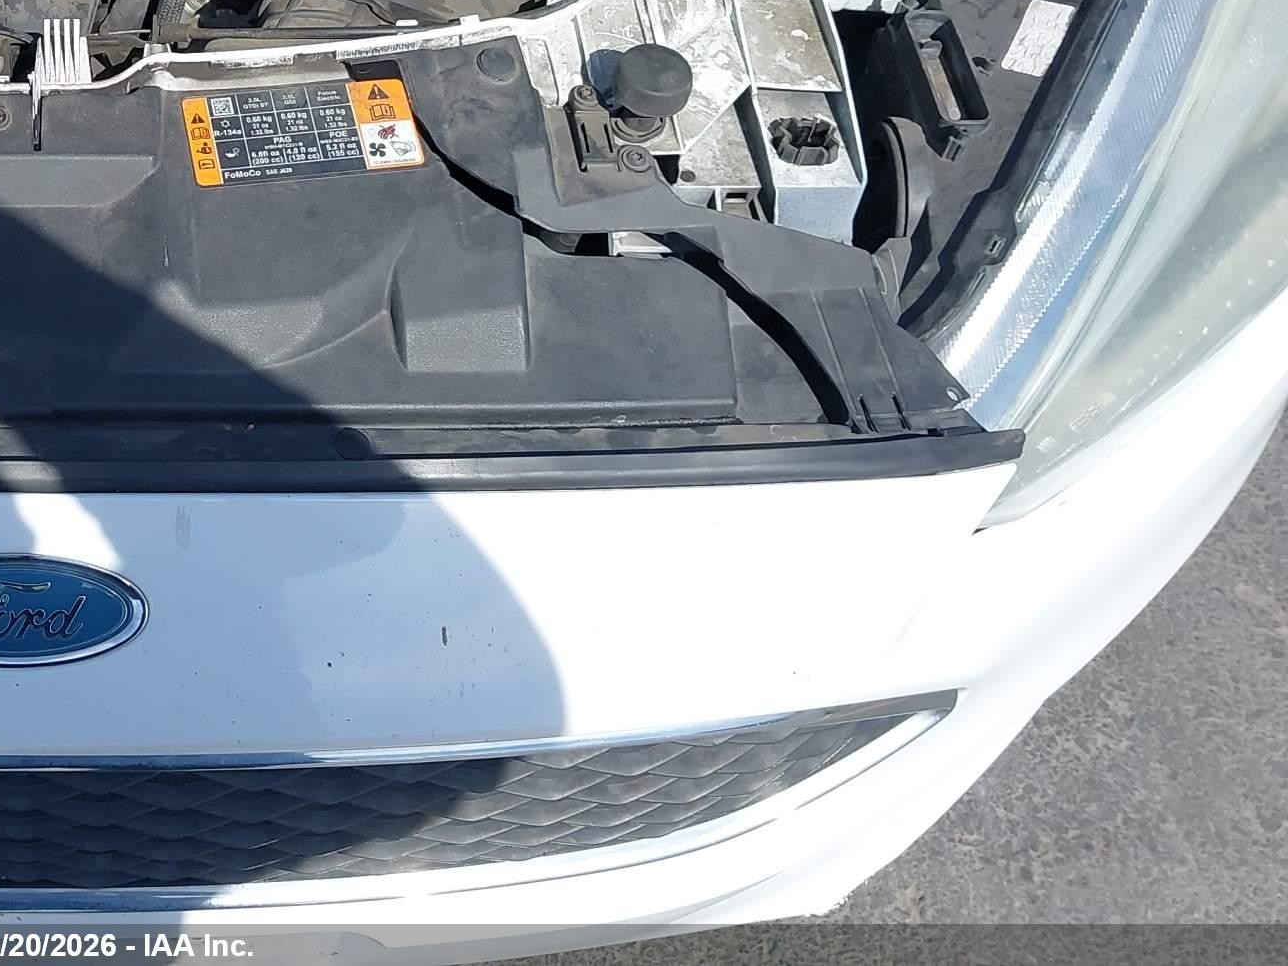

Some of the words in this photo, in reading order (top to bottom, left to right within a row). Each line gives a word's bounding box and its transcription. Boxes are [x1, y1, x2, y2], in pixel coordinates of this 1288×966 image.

[280, 112, 296, 120] 0.60
[297, 112, 308, 120] kg
[336, 108, 346, 116] kg
[246, 116, 262, 124] 0.60
[262, 115, 273, 123] kg
[214, 129, 242, 137] R-134a
[273, 136, 293, 144] PAG
[286, 147, 299, 155] 4.0
[326, 143, 338, 151] 5.2
[289, 154, 306, 162] (120
[307, 152, 321, 160] cc)
[328, 150, 345, 159] (155
[252, 157, 270, 166] (200
[224, 170, 261, 179] FoMoCo
